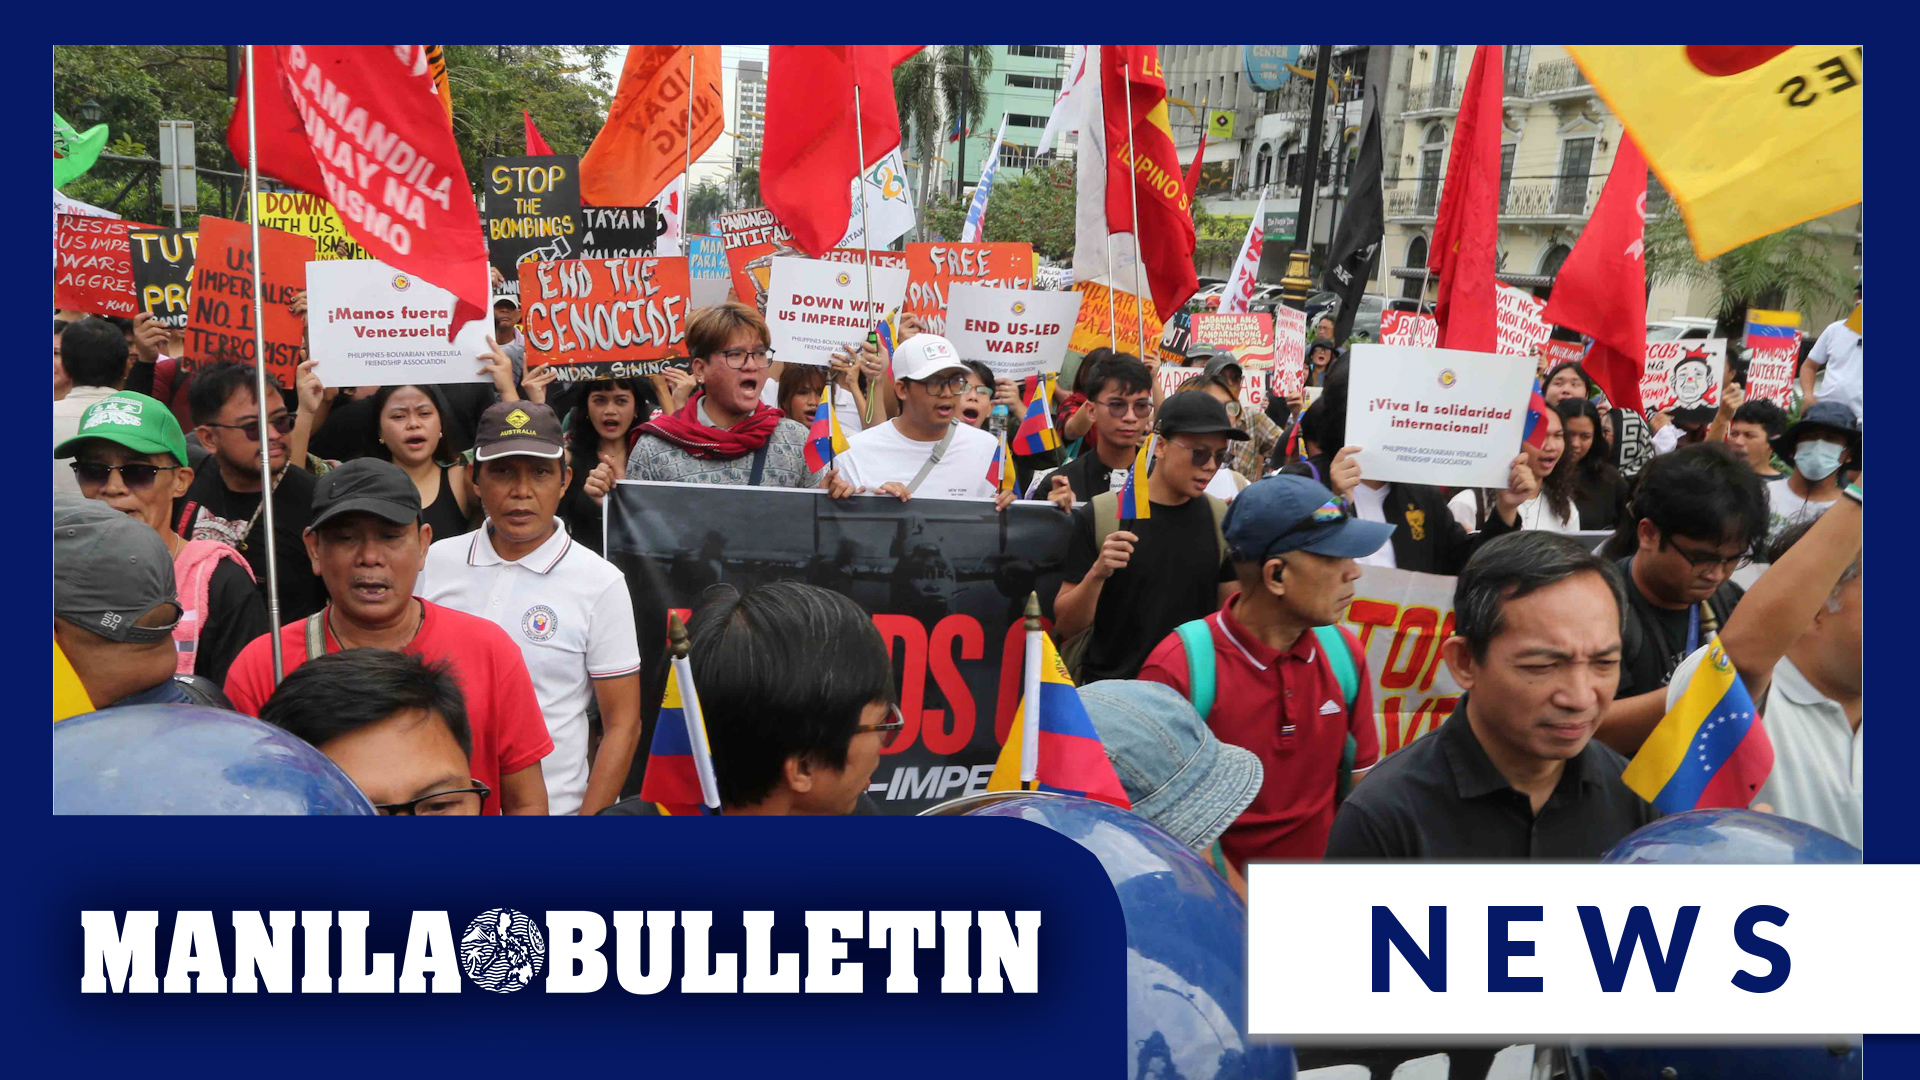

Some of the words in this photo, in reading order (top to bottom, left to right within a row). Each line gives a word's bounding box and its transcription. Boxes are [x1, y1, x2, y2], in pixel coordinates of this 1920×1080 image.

[491, 165, 566, 195] STOP
[1116, 141, 1180, 200] ILIPINO
[266, 192, 327, 216] DOWN
[383, 176, 427, 230] NA
[513, 198, 542, 216] THE
[309, 216, 340, 233] U.S.
[489, 215, 575, 241] BOMBINGS
[581, 208, 646, 230] TAYAN
[59, 233, 87, 250] US
[722, 225, 797, 250] INTIFAD
[61, 252, 131, 274] WARS
[930, 245, 992, 277] FREE
[198, 269, 306, 305] IMPERALIS
[537, 261, 593, 299] END
[604, 258, 661, 297] THE
[195, 296, 231, 329] NO.
[236, 304, 255, 331] 1
[328, 307, 395, 323] ¡Manos
[401, 306, 448, 320] fuera
[791, 294, 844, 310] DOWN
[849, 300, 885, 314] WIH
[778, 310, 797, 321] US
[353, 324, 452, 339] Venezuela!
[965, 318, 1000, 333] END
[1007, 323, 1061, 336] US-LED
[347, 351, 425, 359] PHILIPPINES-BOLIVARIAN
[985, 339, 1039, 354] WARS!
[365, 359, 402, 367] FRIENDSHIP
[403, 358, 447, 366] ASSOCIATION
[1369, 398, 1410, 412] ¡Viva
[1415, 401, 1429, 413] la
[1434, 404, 1512, 420] solidaridad
[500, 428, 537, 437] AUSTRALIA
[1391, 417, 1489, 435] internacional!
